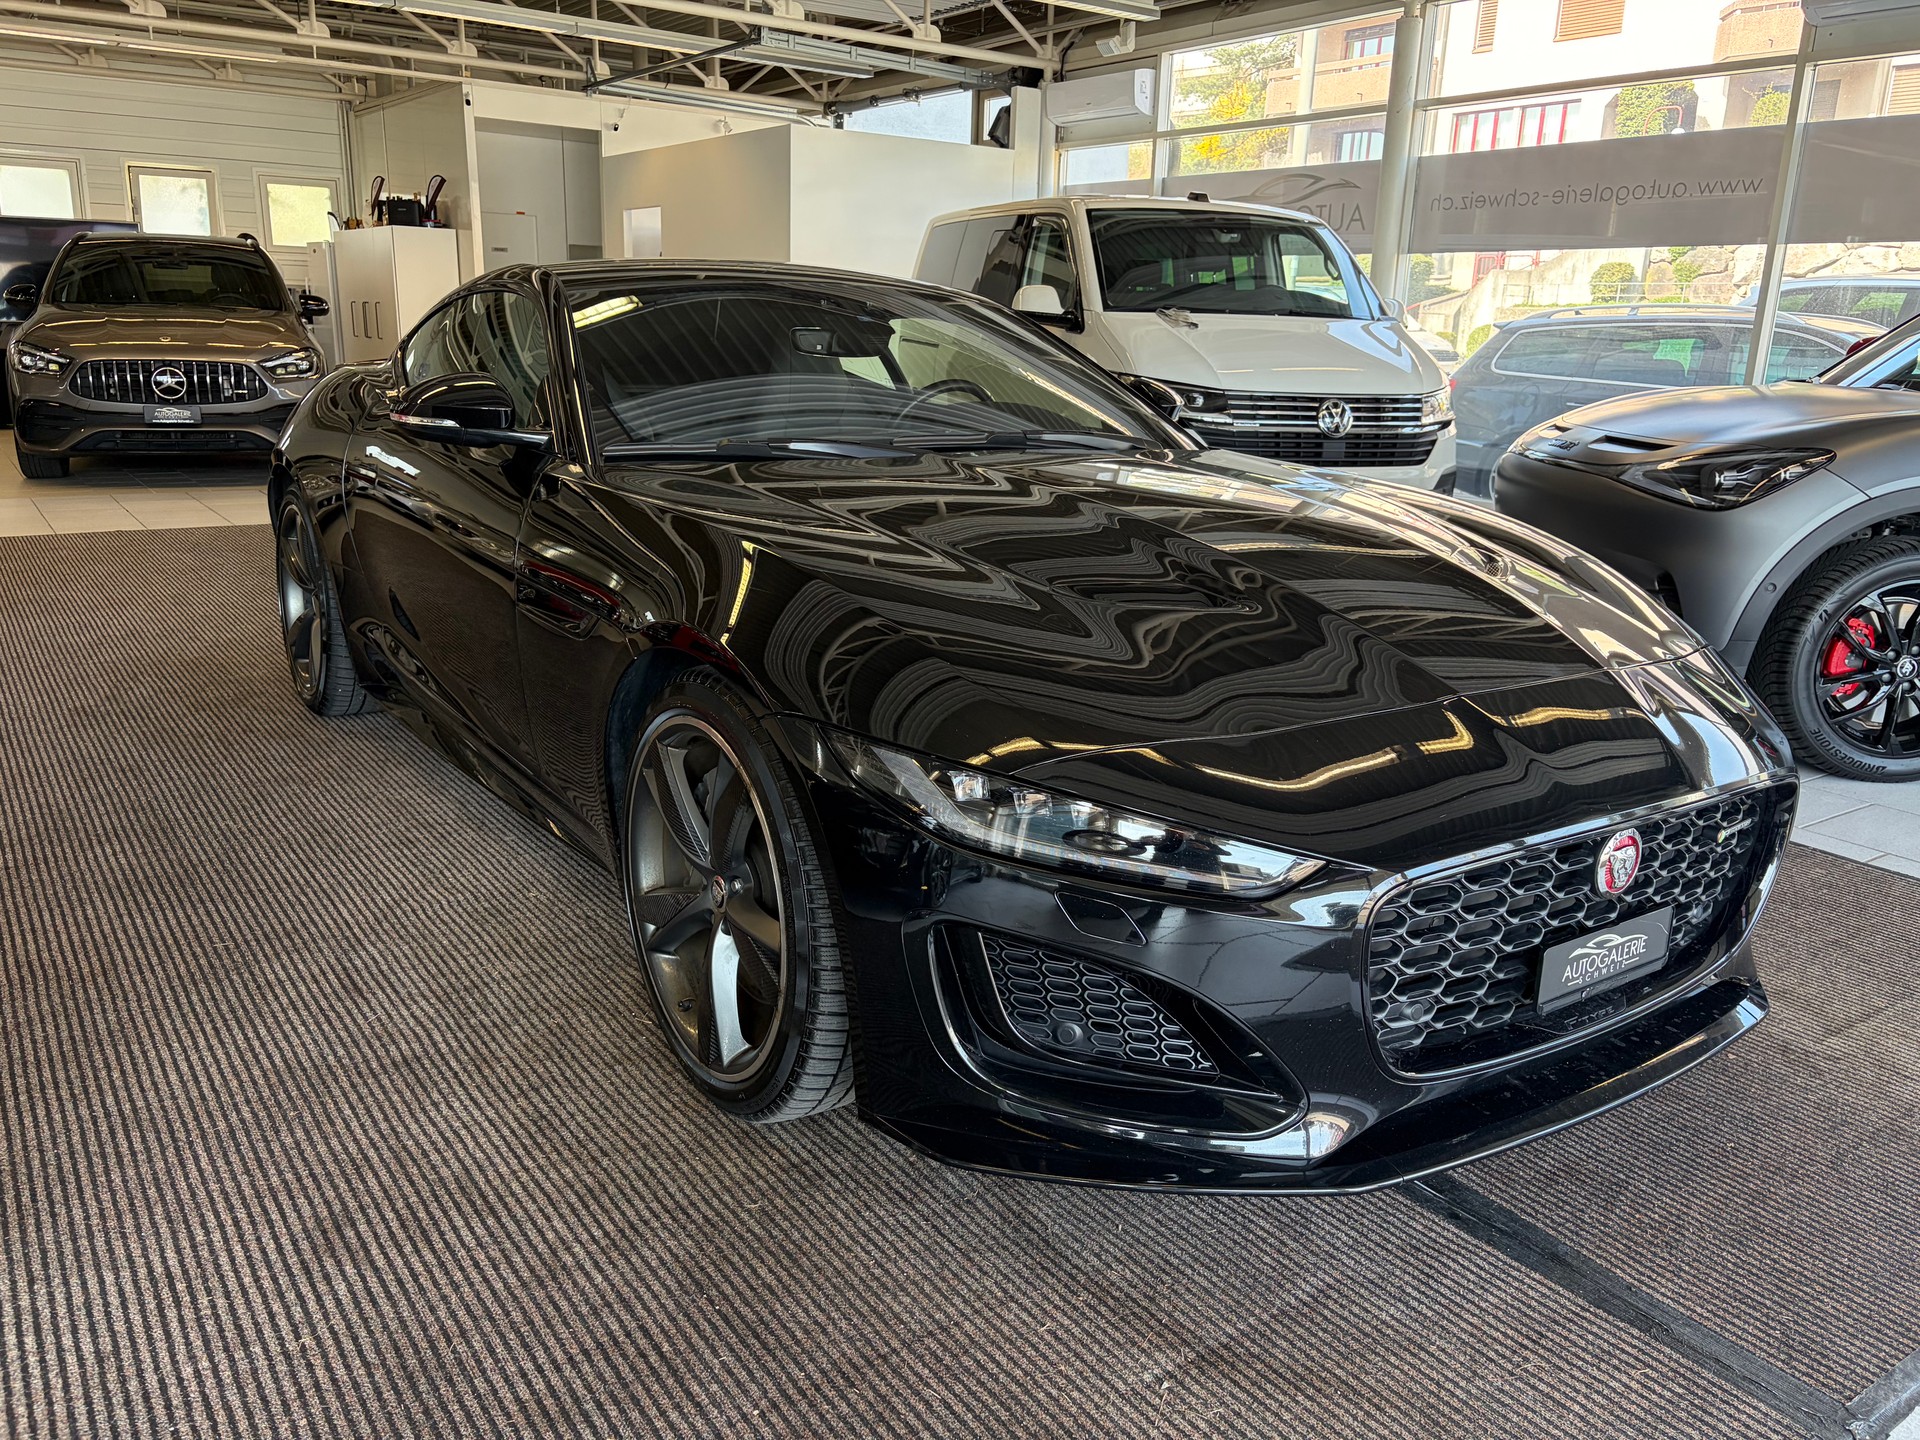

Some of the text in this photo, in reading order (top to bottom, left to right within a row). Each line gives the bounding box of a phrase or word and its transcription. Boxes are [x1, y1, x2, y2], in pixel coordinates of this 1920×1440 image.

[1809, 727, 1887, 776] BRIDGESTONE
[1562, 938, 1647, 982] AUTOGALERIE
[1578, 960, 1626, 984] SCHWEIZ
[1564, 1006, 1614, 1031] F-TYPE
